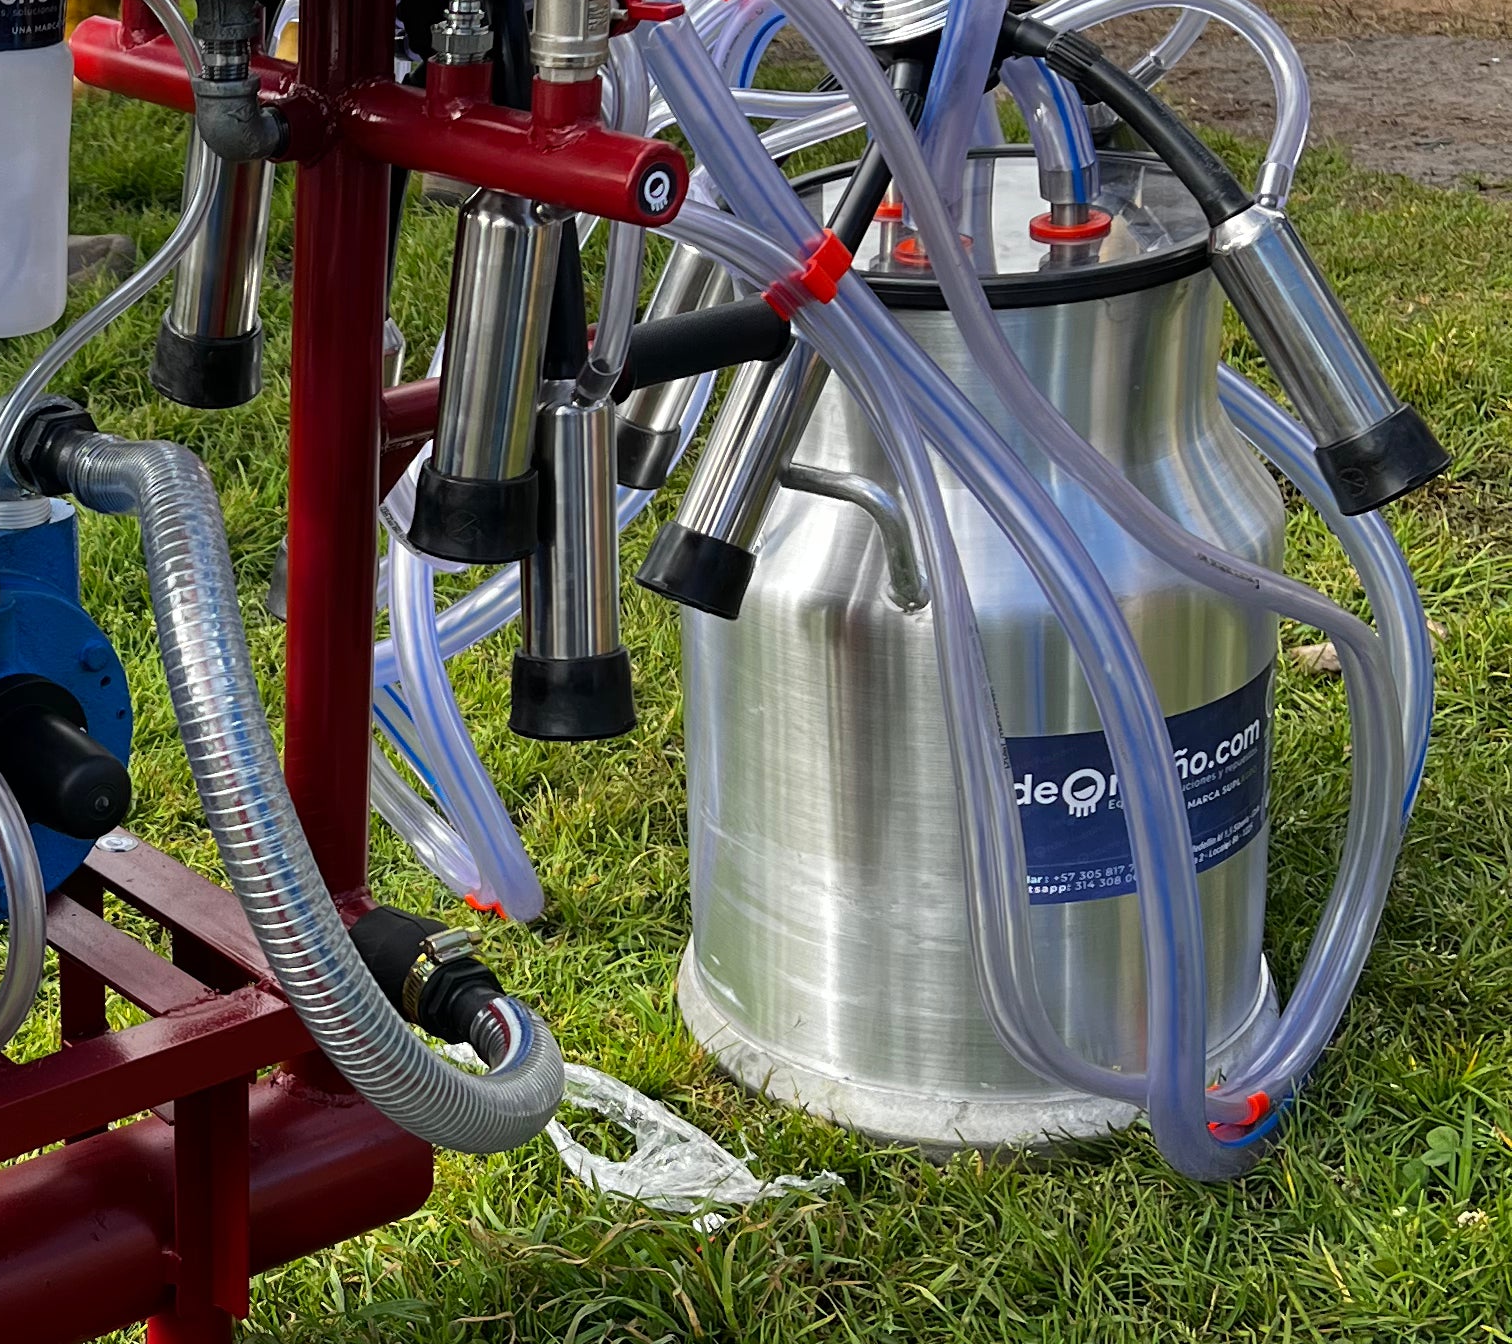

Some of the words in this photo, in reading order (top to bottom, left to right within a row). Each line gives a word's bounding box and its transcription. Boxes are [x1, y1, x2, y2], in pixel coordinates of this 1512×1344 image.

[11, 25, 33, 35] UNA
[1053, 872, 1076, 883] +57
[1079, 869, 1102, 881] 305
[1105, 865, 1125, 877] 817
[1074, 880, 1095, 891] 314
[1099, 876, 1122, 888] 308
